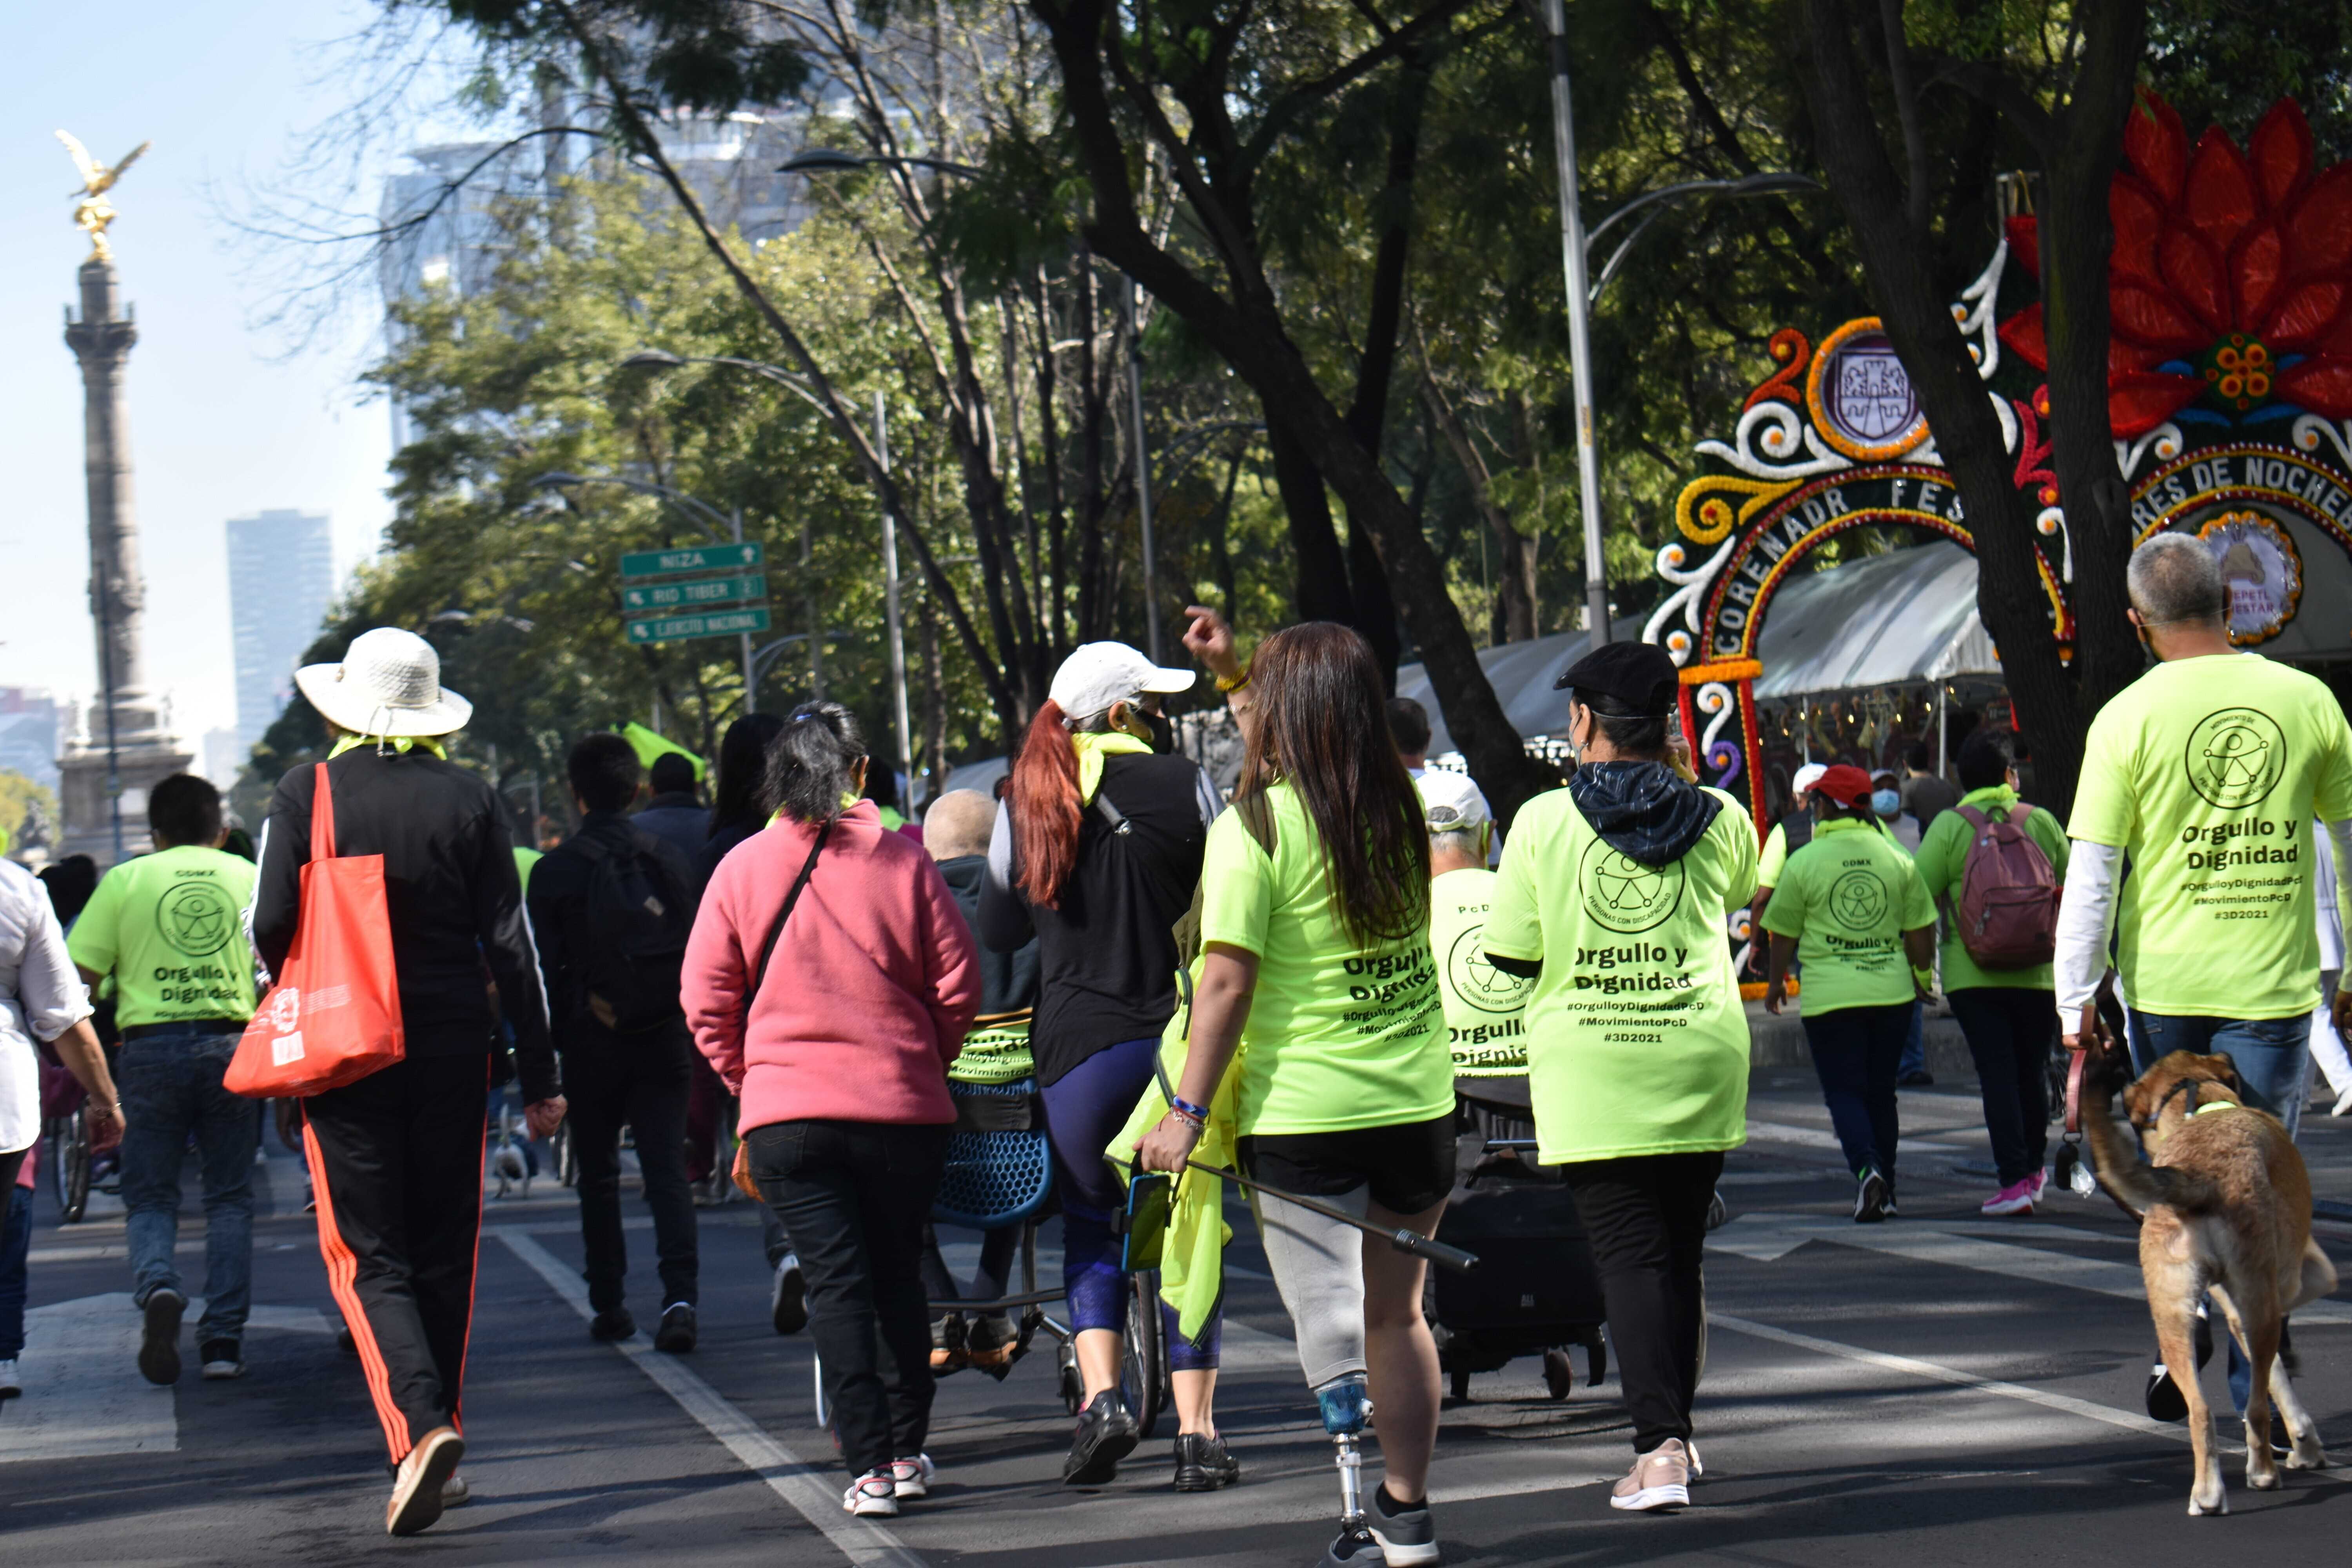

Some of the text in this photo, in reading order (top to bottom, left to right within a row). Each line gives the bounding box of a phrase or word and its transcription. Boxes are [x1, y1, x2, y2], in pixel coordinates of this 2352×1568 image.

[2192, 457, 2233, 492] DE
[659, 552, 705, 568] NIZA
[1715, 489, 1849, 654] CORENADR
[653, 588, 679, 604] RIO
[685, 583, 728, 600] TIBER
[2232, 601, 2274, 614] ESTAR
[2182, 817, 2297, 845] Orgullo y
[2188, 844, 2298, 871] Dignidad
[1588, 895, 1616, 922] PERSONAS
[1633, 892, 1672, 924] DISCAPACIDAD
[2194, 893, 2291, 906] #MovimientoPcD
[2215, 910, 2269, 920] #3D2021
[1675, 948, 1688, 967] y
[1461, 981, 1488, 1004] PERSONAS
[1574, 972, 1692, 995] Dignidad
[1567, 1001, 1704, 1012] #OrgulloyDignidadPcD
[1579, 1018, 1687, 1027] #MovimientoPcD
[1604, 1033, 1662, 1043] #3D2021
